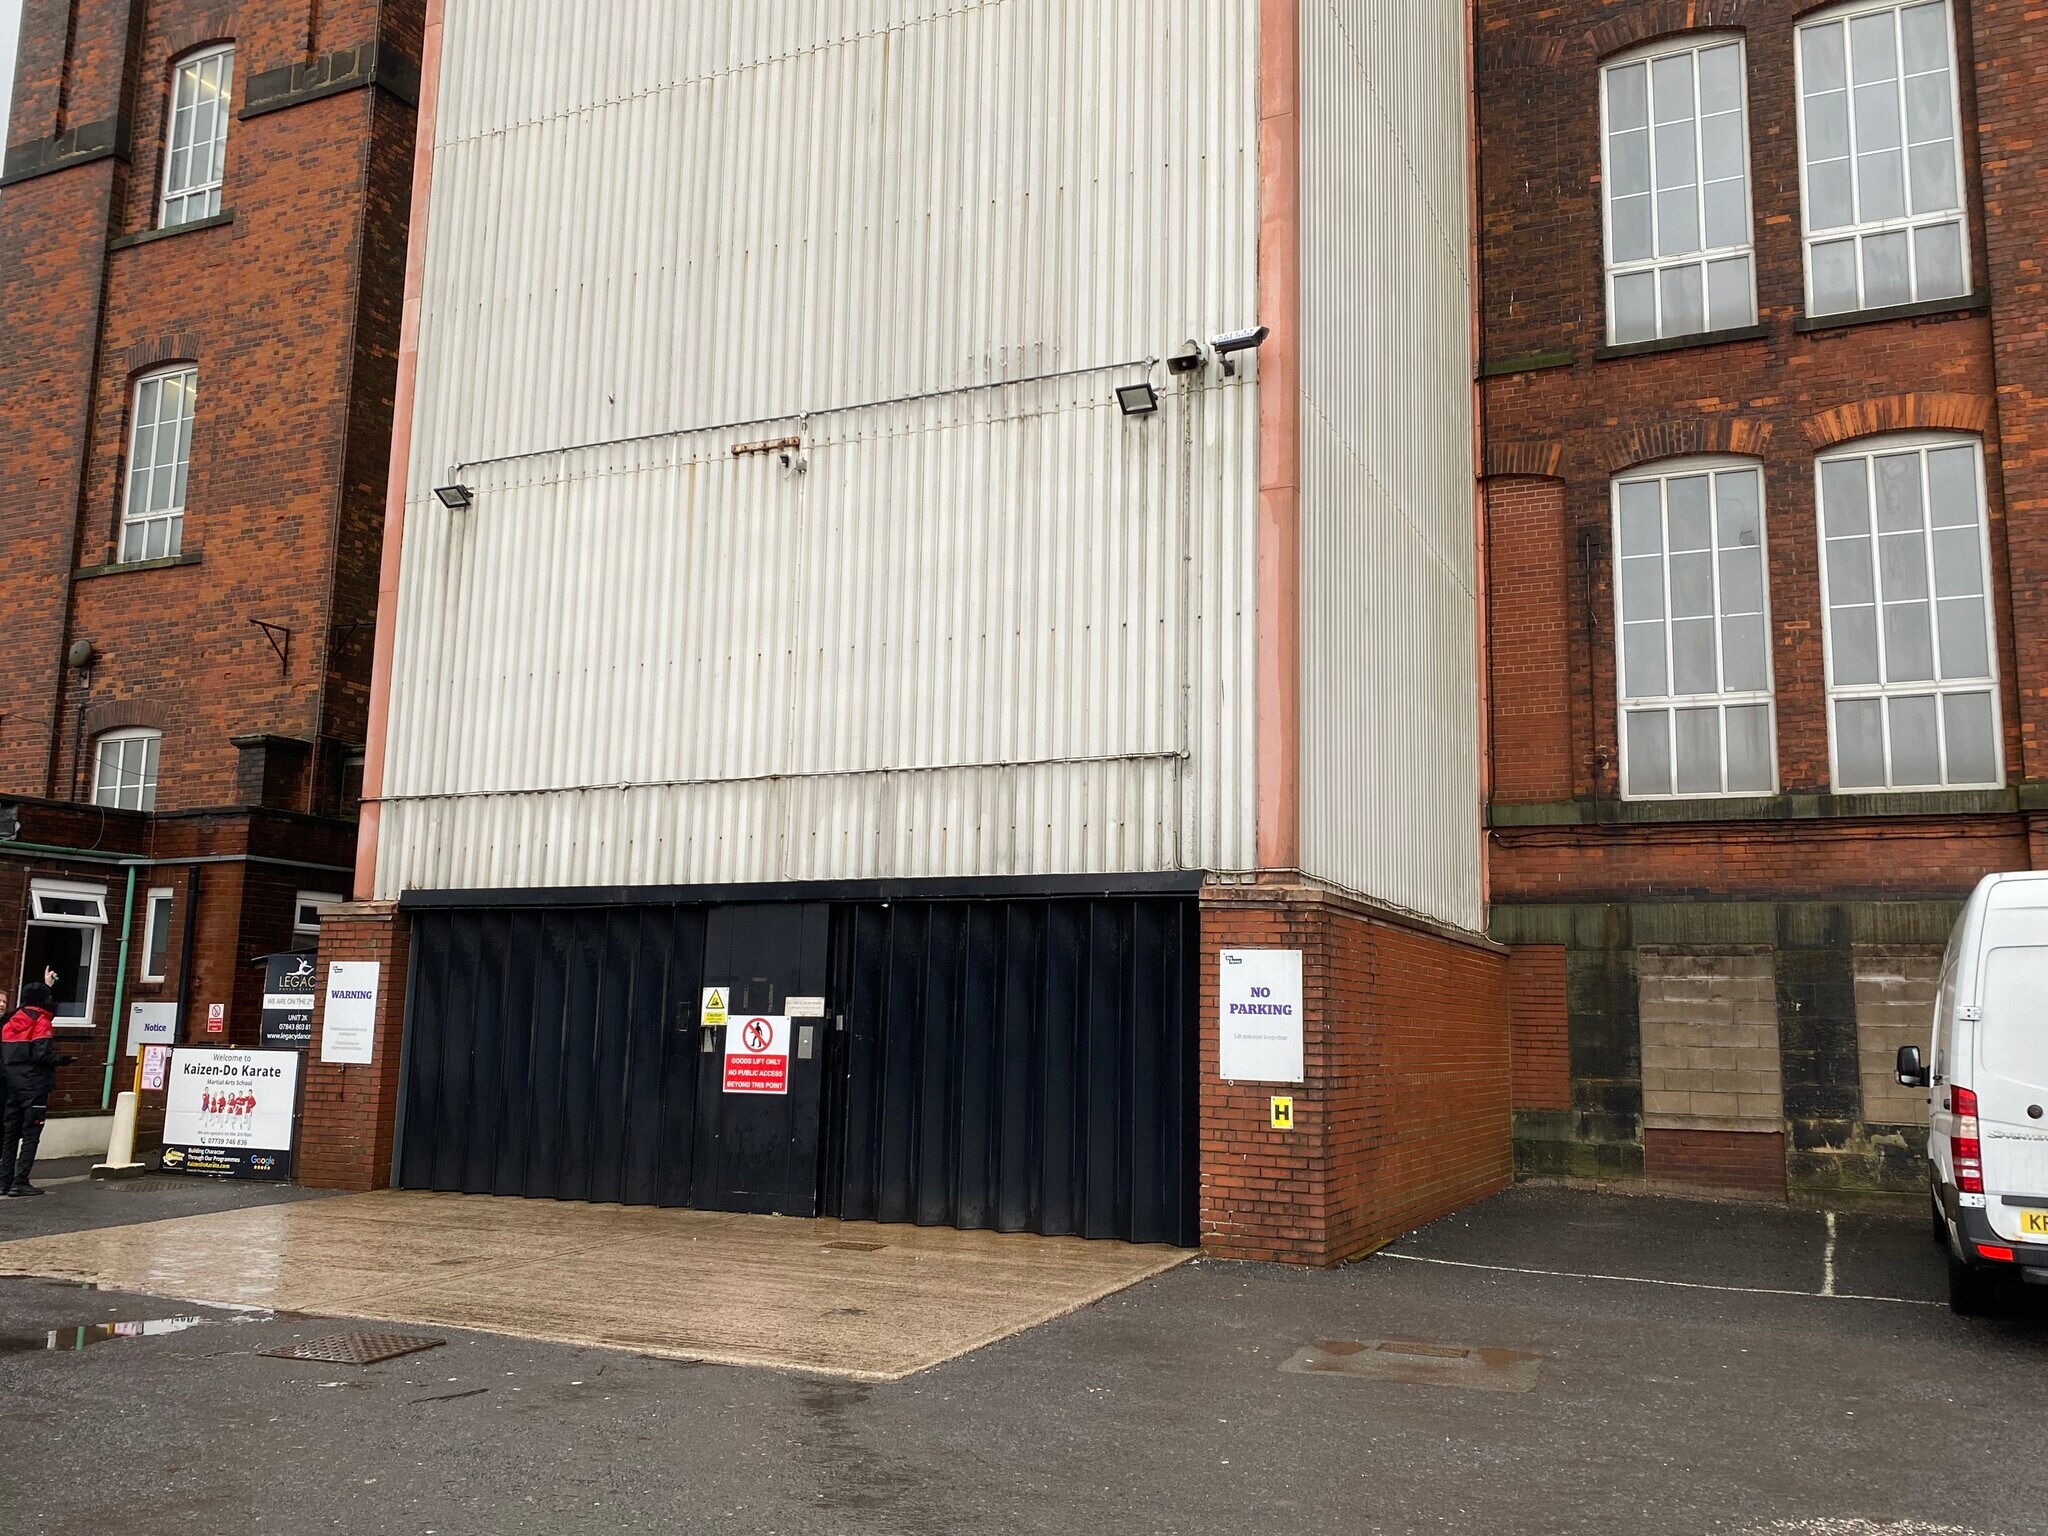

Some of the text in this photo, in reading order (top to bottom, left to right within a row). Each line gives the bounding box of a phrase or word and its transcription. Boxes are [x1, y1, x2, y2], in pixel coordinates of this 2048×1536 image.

[331, 990, 372, 999] WARNING
[1251, 987, 1270, 998] NO
[1230, 1004, 1292, 1015] PARKING
[144, 1023, 167, 1032] Notice
[213, 1053, 243, 1062] Welcome
[184, 1063, 281, 1077] Kaizen-Do Karate
[1275, 1105, 1289, 1120] H
[1988, 1131, 2048, 1141] SPRINTE
[251, 1154, 275, 1166] Google
